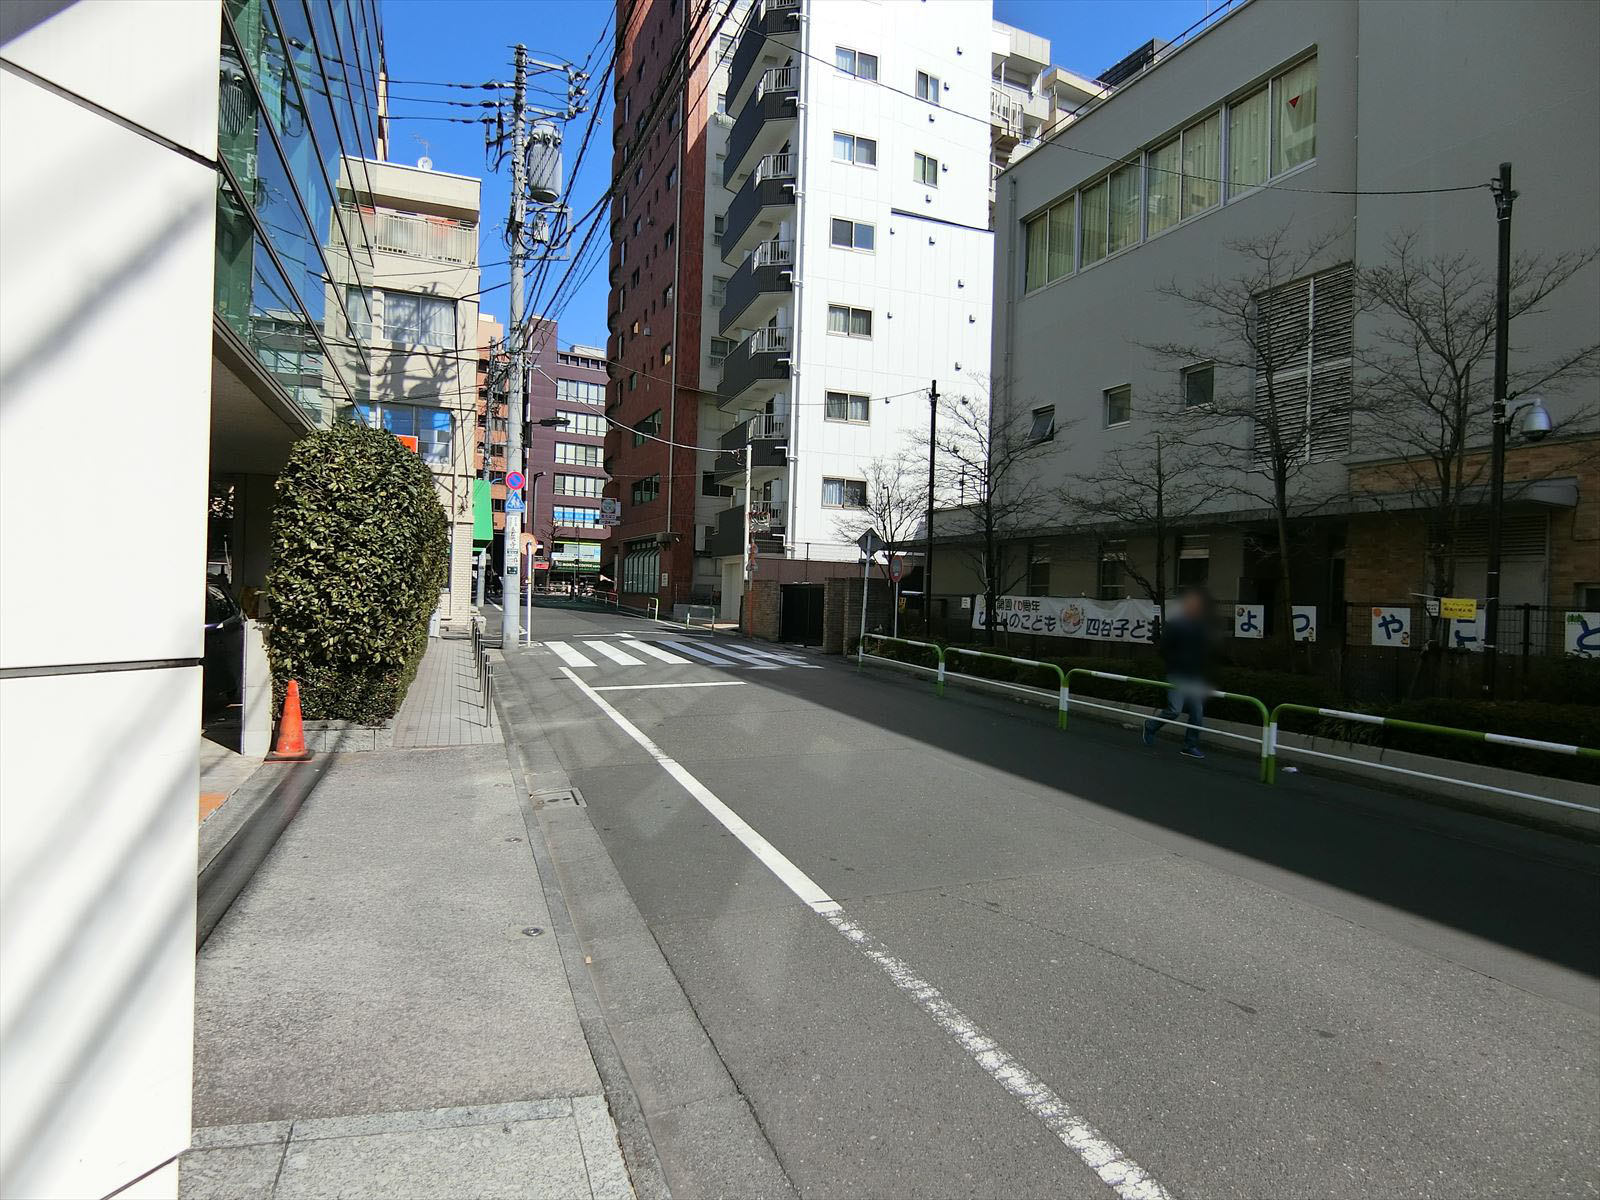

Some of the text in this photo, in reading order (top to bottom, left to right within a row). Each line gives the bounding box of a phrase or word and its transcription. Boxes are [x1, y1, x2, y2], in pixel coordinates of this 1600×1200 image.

[996, 598, 1041, 613] 開園10周年
[1240, 610, 1258, 632] よ
[1292, 614, 1311, 633] つ
[1378, 614, 1403, 639] や
